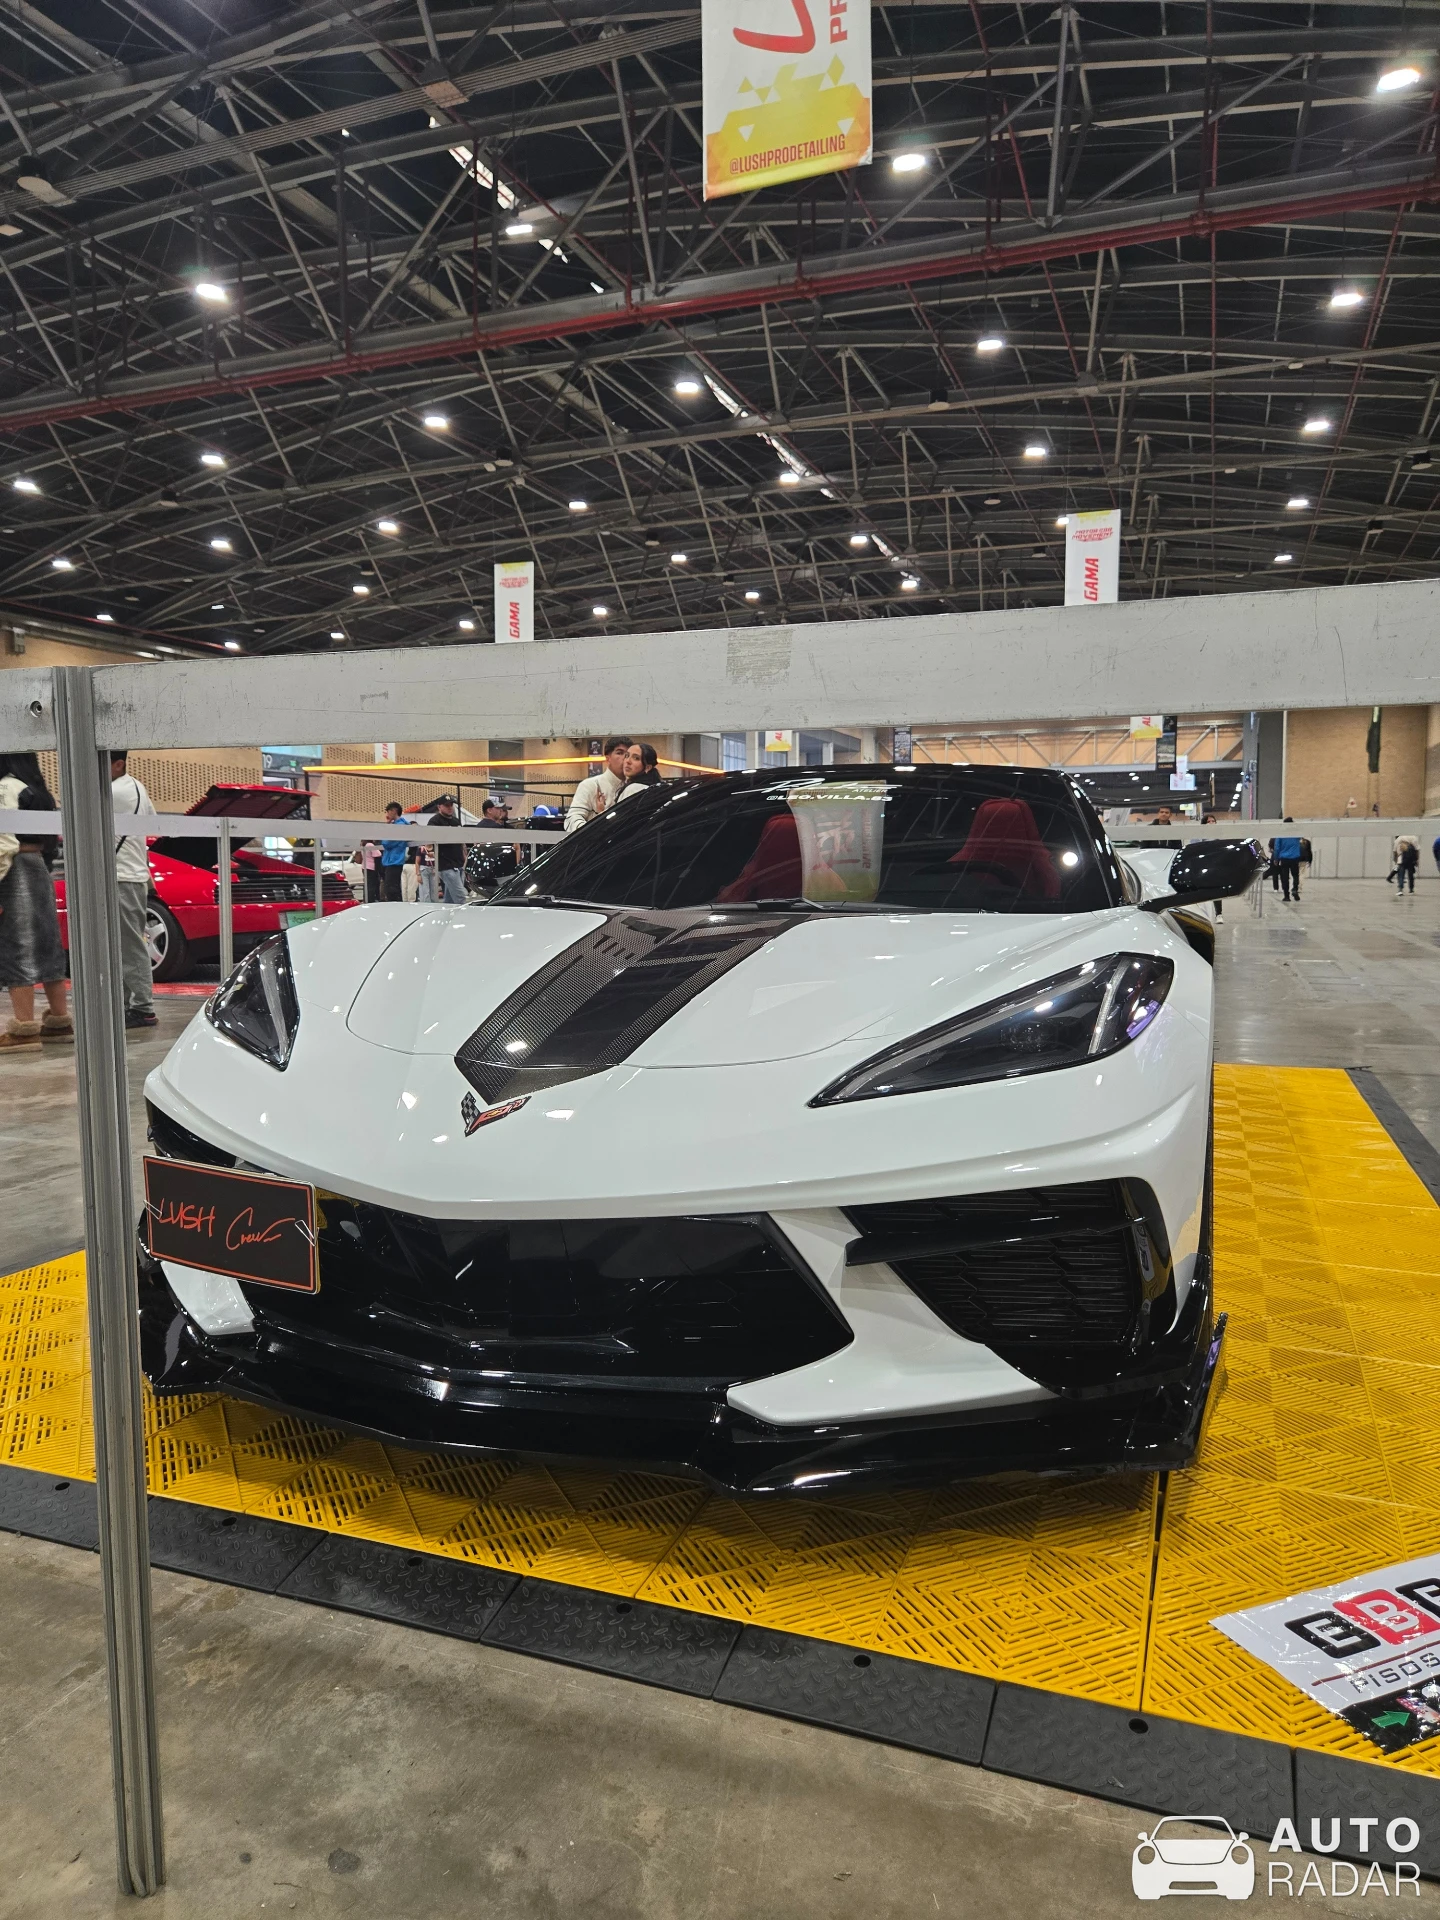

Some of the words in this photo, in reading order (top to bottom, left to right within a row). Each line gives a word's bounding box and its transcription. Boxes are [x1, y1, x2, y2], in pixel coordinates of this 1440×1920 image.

[729, 133, 846, 175] @LUSHPRODETAILING
[1084, 557, 1099, 602] GAMA
[509, 601, 520, 639] GAMA
[159, 1198, 216, 1238] LUSH
